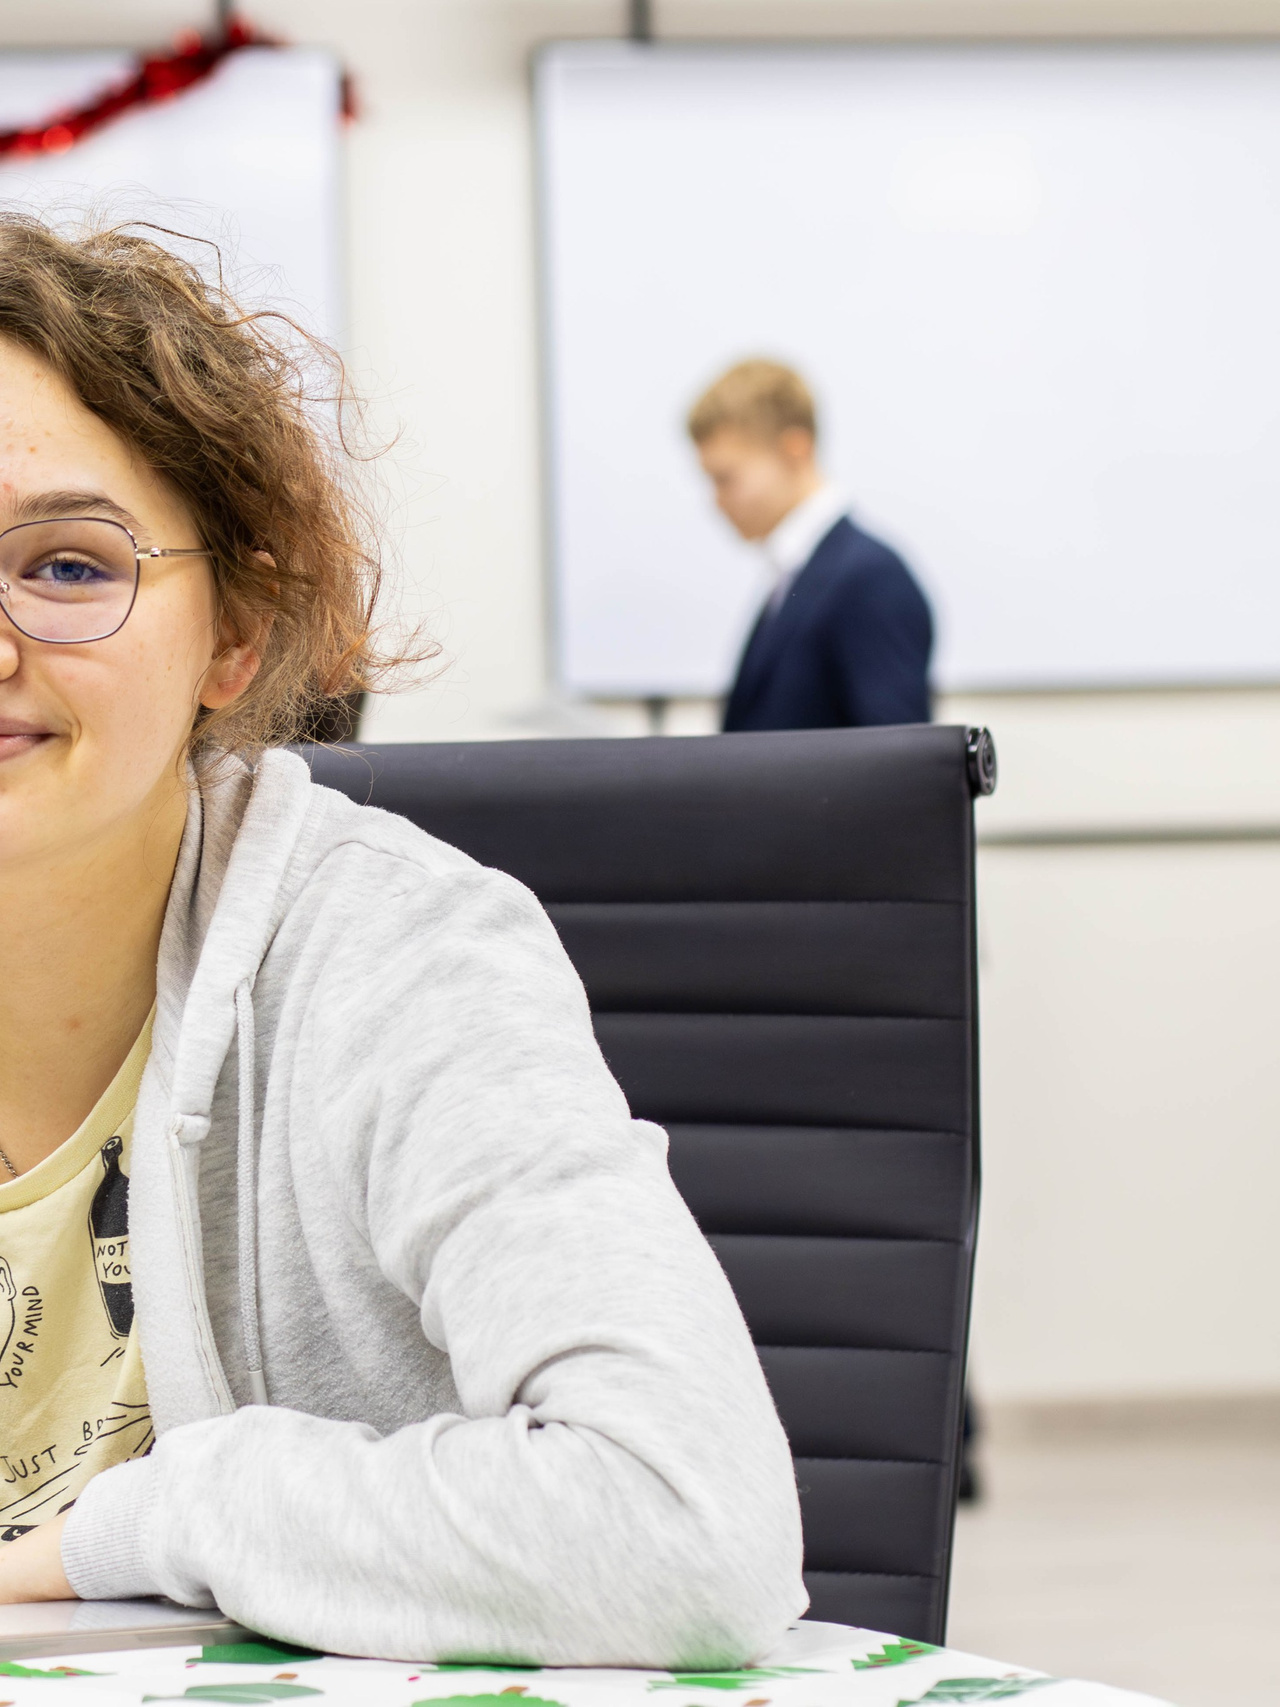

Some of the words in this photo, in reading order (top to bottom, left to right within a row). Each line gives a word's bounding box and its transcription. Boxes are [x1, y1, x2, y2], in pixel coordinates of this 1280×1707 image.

[96, 1240, 129, 1258] NOT
[21, 1285, 44, 1337] MIND
[0, 1443, 57, 1484] JUST
